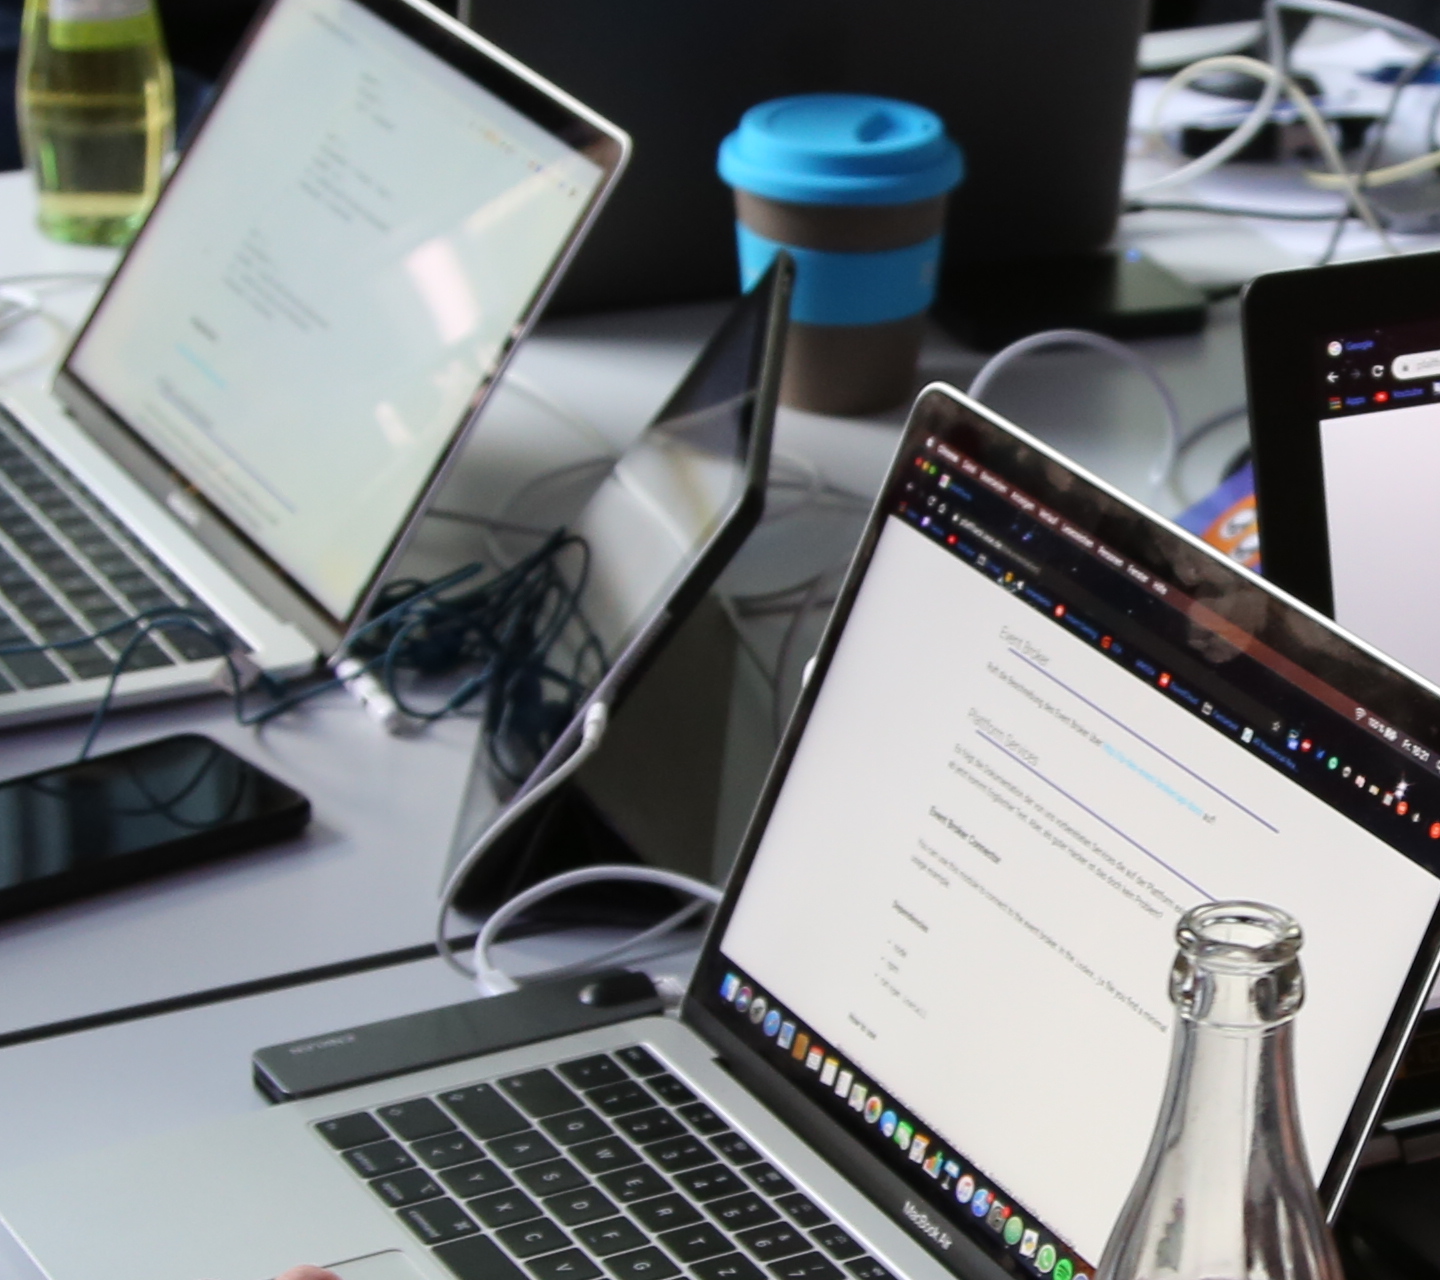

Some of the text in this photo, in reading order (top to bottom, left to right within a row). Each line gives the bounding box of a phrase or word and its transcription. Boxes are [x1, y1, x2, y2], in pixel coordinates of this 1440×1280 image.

[998, 624, 1051, 669] Event Broker
[928, 804, 1002, 866] Event Broker Connector
[902, 1200, 954, 1251] MacBook Air
